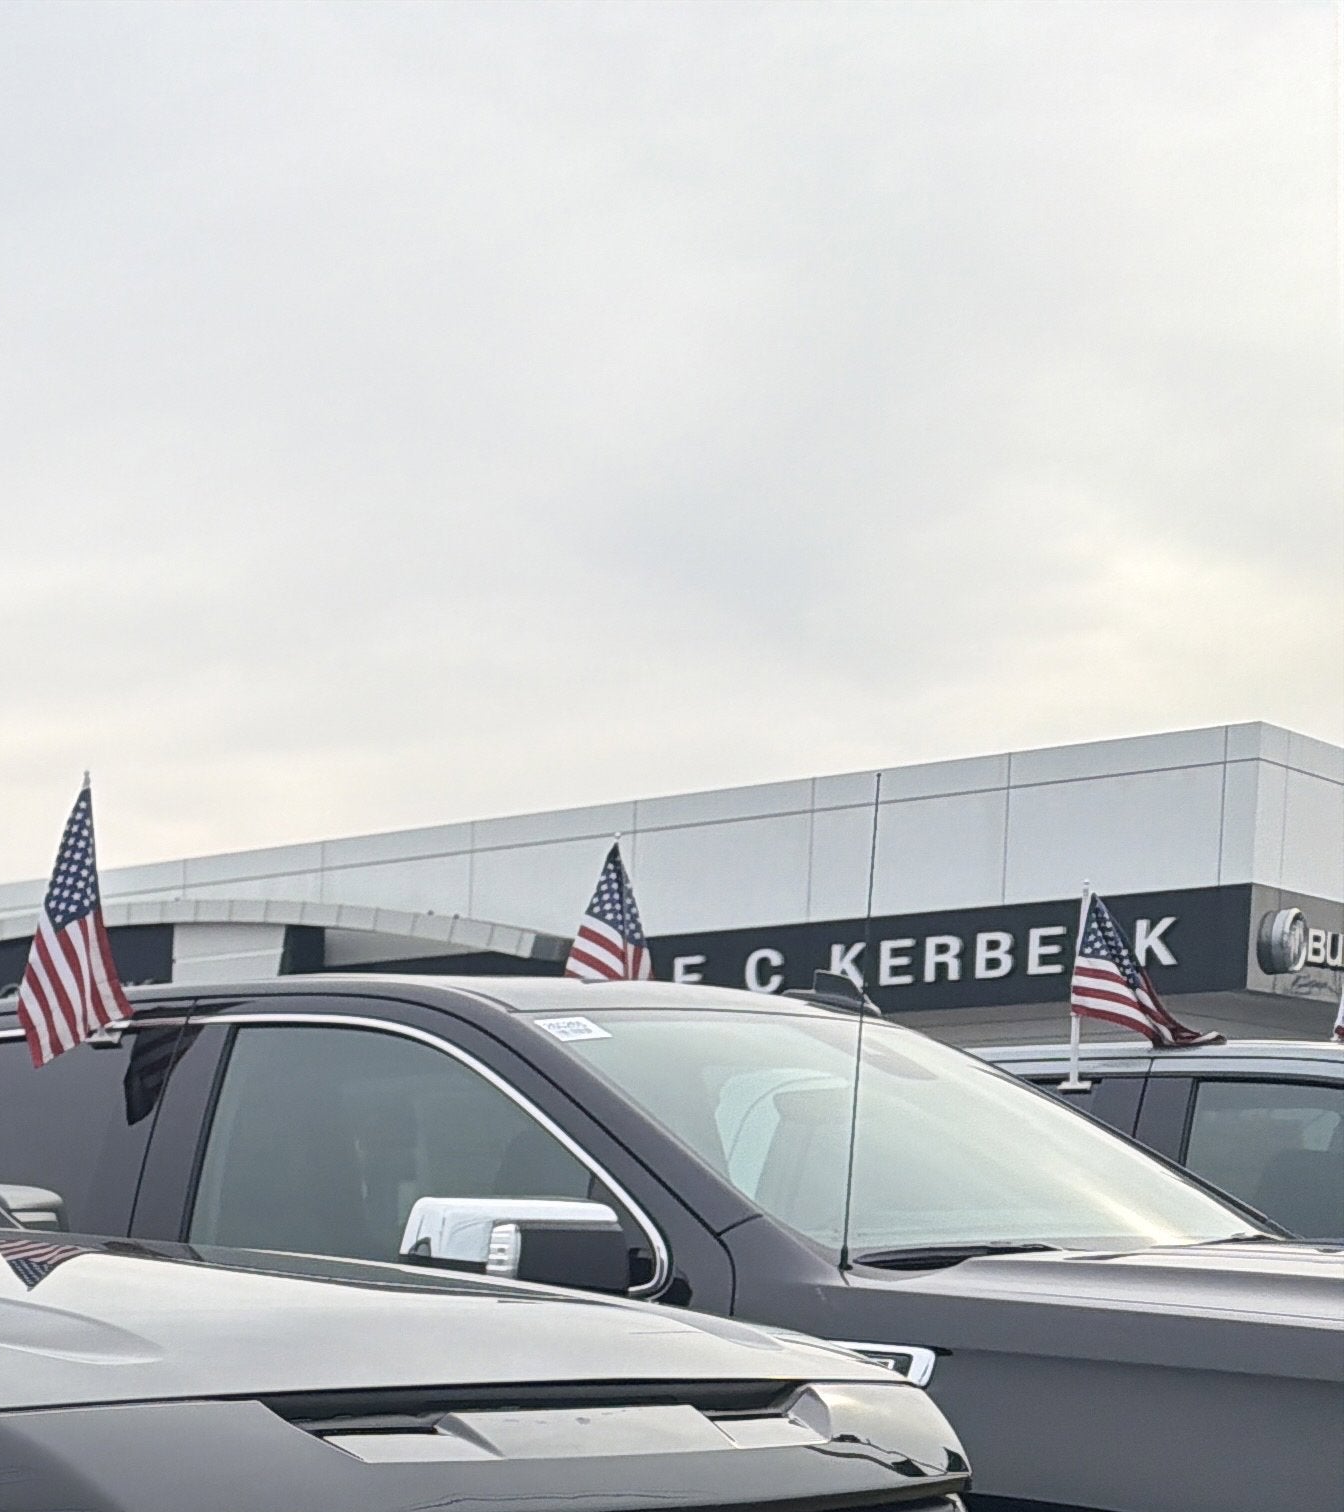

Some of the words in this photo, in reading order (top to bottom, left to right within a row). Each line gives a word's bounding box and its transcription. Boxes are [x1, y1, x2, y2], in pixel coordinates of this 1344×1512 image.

[744, 948, 785, 994] C
[828, 916, 1179, 992] KERBEK
[1307, 927, 1344, 967] BU
